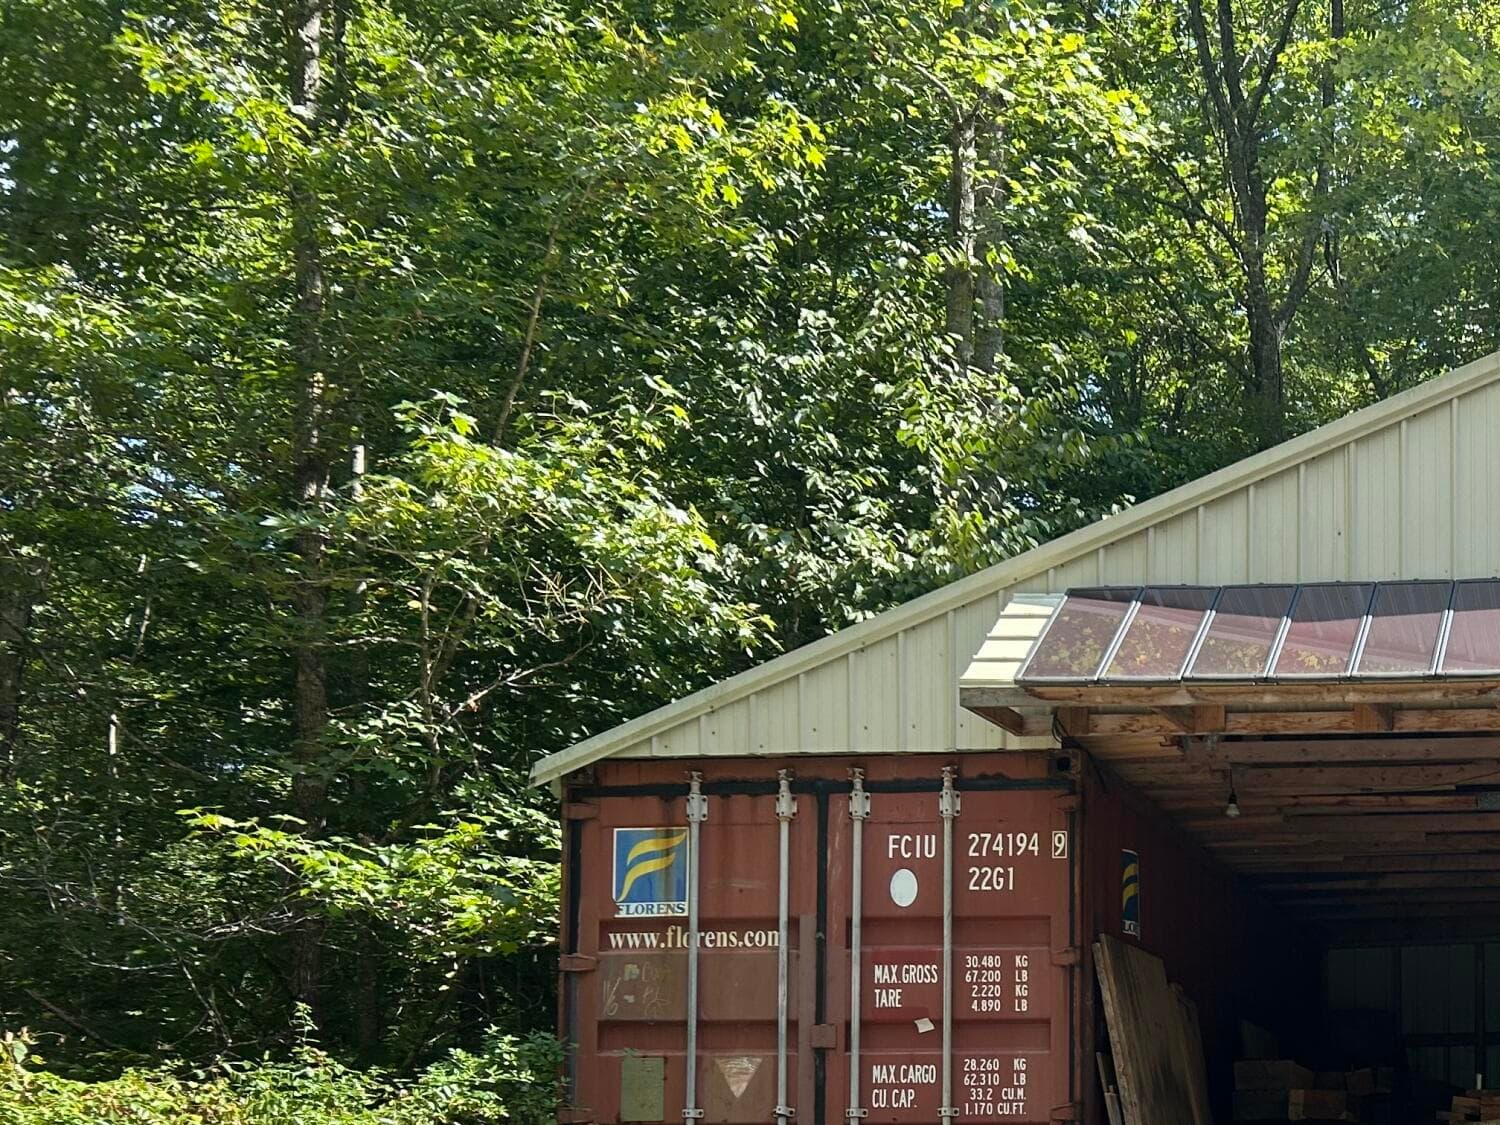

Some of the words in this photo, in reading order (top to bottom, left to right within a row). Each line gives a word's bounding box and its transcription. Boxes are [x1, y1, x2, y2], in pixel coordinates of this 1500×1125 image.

[888, 835, 936, 858] FCIU
[968, 833, 1039, 857] 274194
[1053, 832, 1066, 857] 9
[968, 867, 1014, 890] 22G1
[965, 955, 1001, 968] 30.480
[1015, 955, 1028, 967] KG
[965, 970, 1001, 982] 67.200
[1015, 970, 1028, 982] LB
[971, 985, 1001, 997] 2.220
[1015, 985, 1028, 997] KG
[874, 989, 902, 1008] TARE
[971, 999, 1001, 1012] 4.890
[1015, 999, 1028, 1012] LB
[963, 1058, 1000, 1071] 28.260
[1013, 1058, 1027, 1071] KG
[963, 1073, 1000, 1086] 62.310
[1013, 1073, 1027, 1085] LB
[970, 1088, 993, 1100] 33.2
[1001, 1088, 1027, 1100] CU.M.
[965, 1103, 993, 1115] 1.170
[997, 1102, 1027, 1115] CU.FT.
